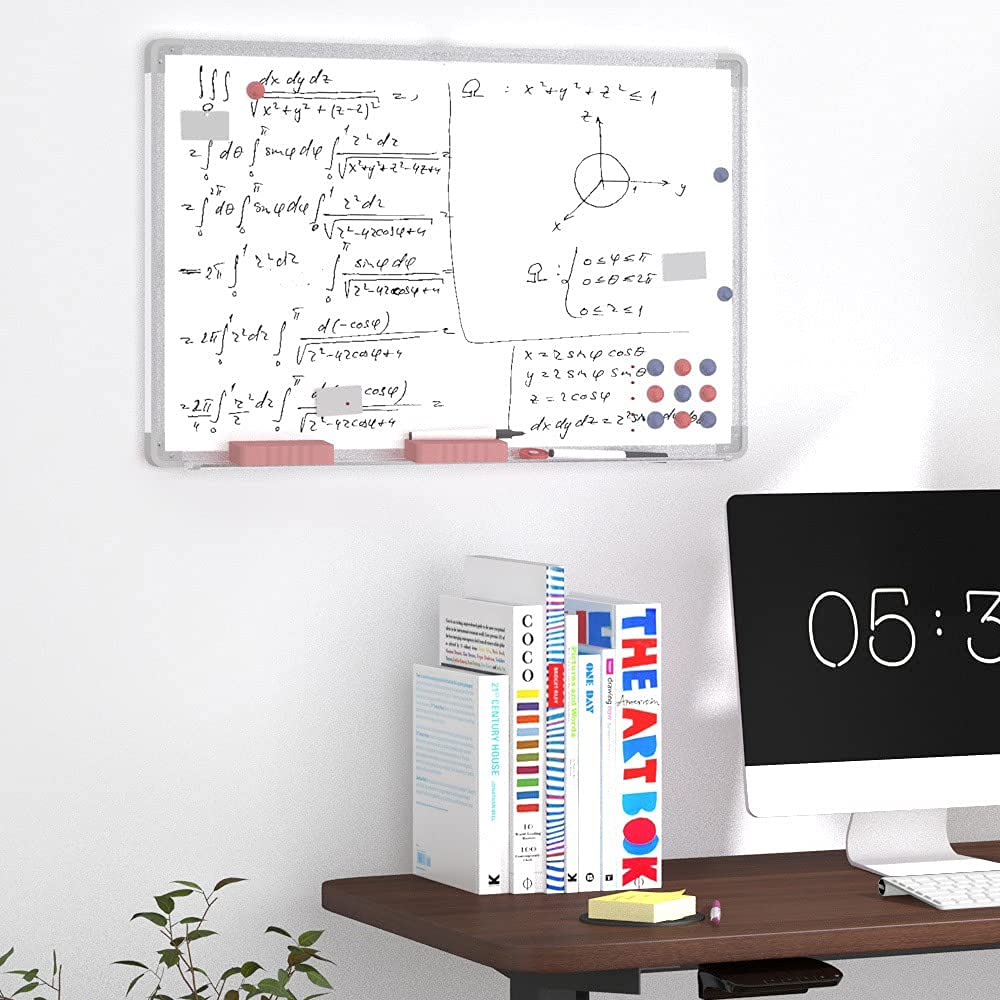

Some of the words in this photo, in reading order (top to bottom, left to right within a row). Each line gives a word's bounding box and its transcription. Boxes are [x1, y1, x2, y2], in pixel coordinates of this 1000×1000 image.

[522, 614, 534, 682] COCO
[621, 608, 658, 692] THE
[586, 662, 595, 687] ONE
[605, 677, 613, 705] drawing
[491, 699, 500, 742] CENTURY
[586, 690, 595, 715] DAY
[491, 743, 500, 776] HOUSE
[621, 707, 658, 784] ART
[621, 791, 660, 887] BOOK
